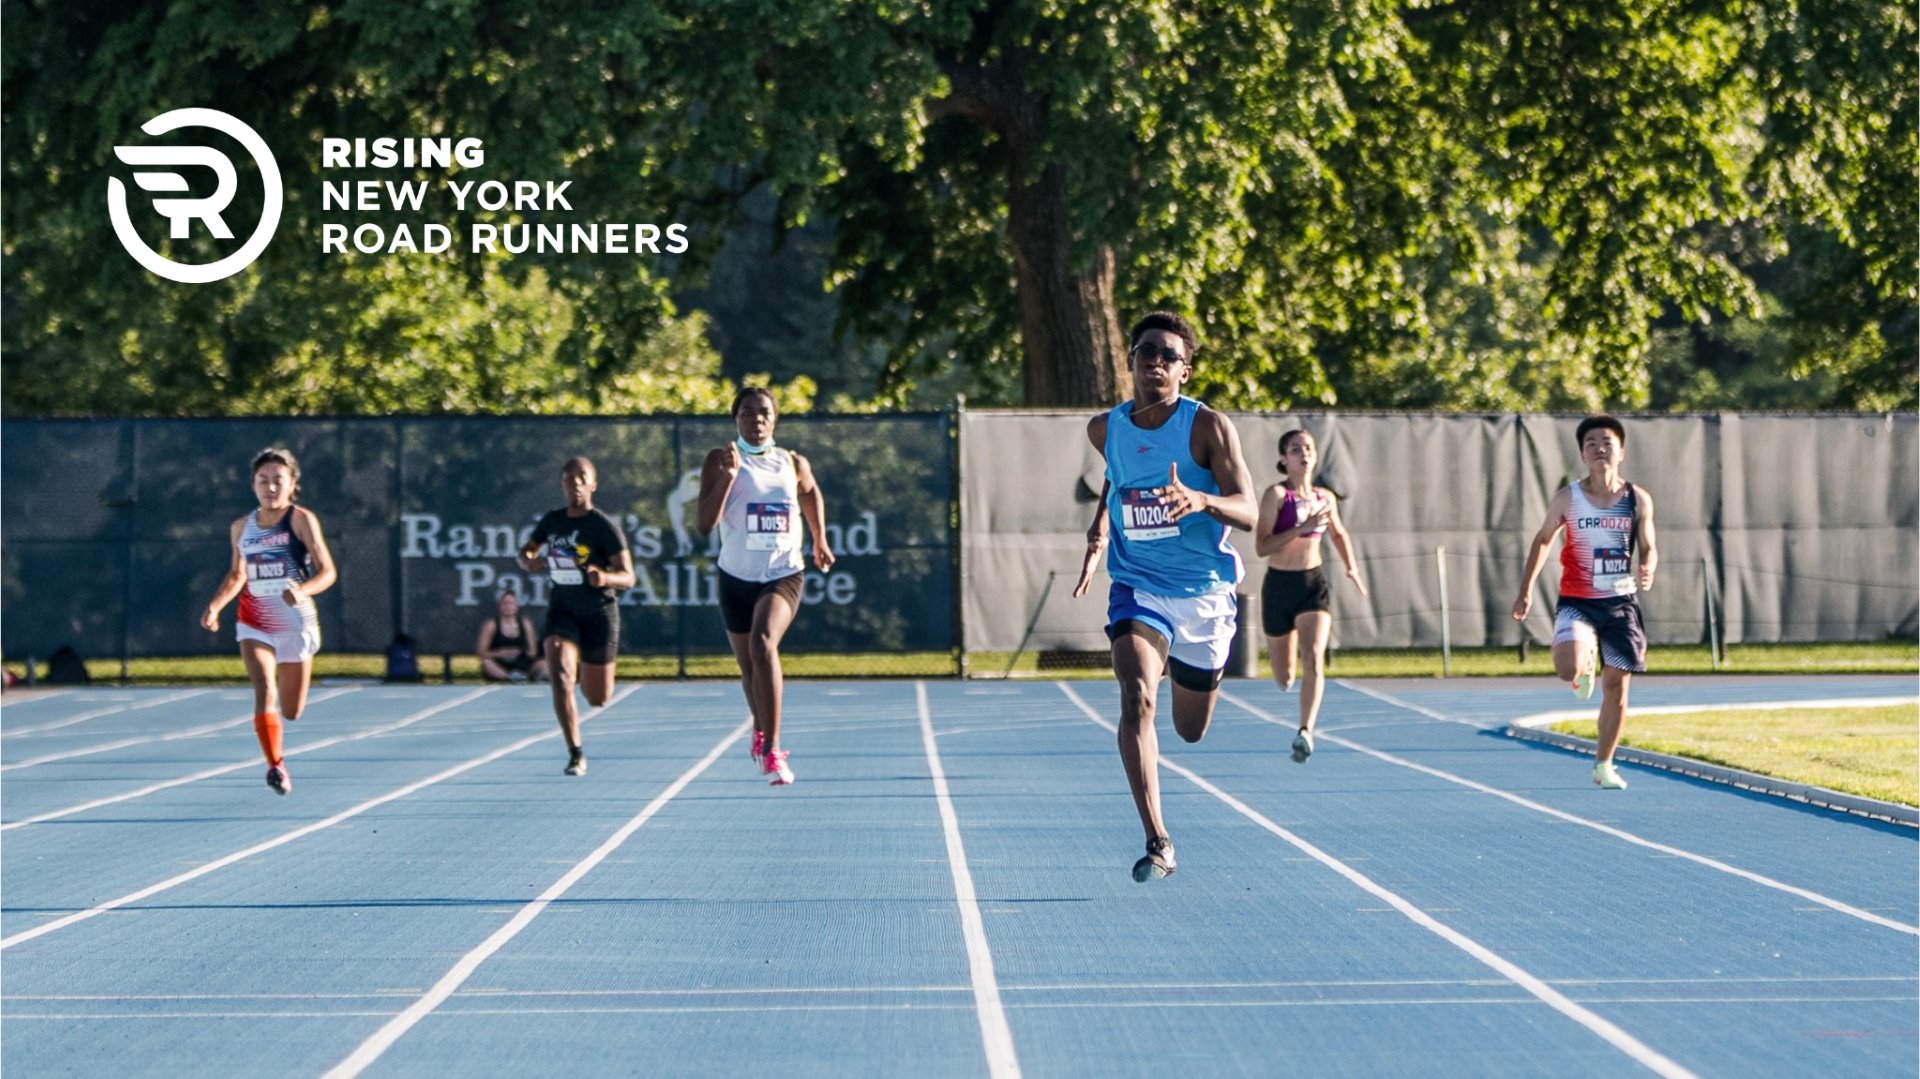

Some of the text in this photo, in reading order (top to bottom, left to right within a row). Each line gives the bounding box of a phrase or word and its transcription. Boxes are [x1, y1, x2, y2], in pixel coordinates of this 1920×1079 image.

[1133, 505, 1171, 526] 10204
[455, 561, 857, 606] Par Allice
